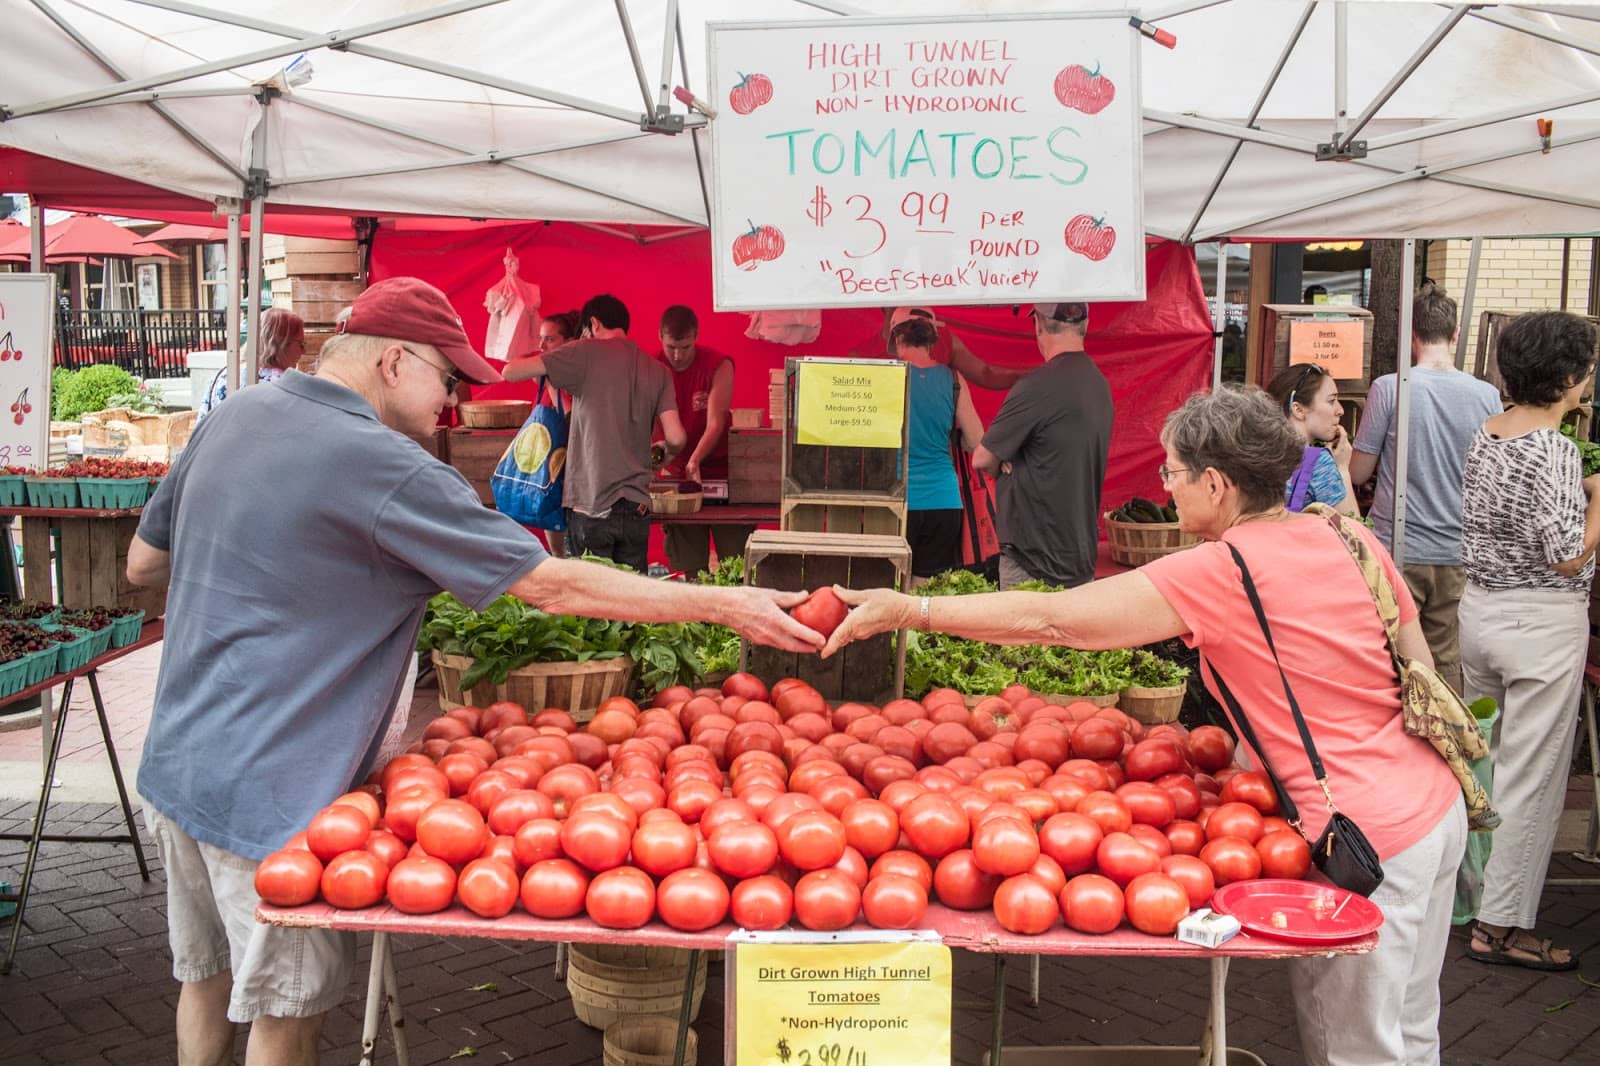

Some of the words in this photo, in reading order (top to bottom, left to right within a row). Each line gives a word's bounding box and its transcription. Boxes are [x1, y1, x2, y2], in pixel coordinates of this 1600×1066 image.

[808, 42, 881, 70] HIGH
[904, 39, 1018, 63] TUNNEL
[831, 67, 898, 93] DIRT
[911, 63, 1012, 88] GROWN
[765, 125, 1089, 187] TOMATOES
[980, 210, 1024, 230] PER
[969, 238, 1040, 257] POUND
[979, 269, 1038, 288] Variety
[832, 376, 855, 385] Salad
[856, 376, 872, 385] Mix
[758, 967, 786, 979] Dirt
[790, 966, 839, 979] Grown
[843, 966, 877, 981] High
[881, 966, 931, 979] Tunnel
[808, 990, 881, 1003] Tomatoes
